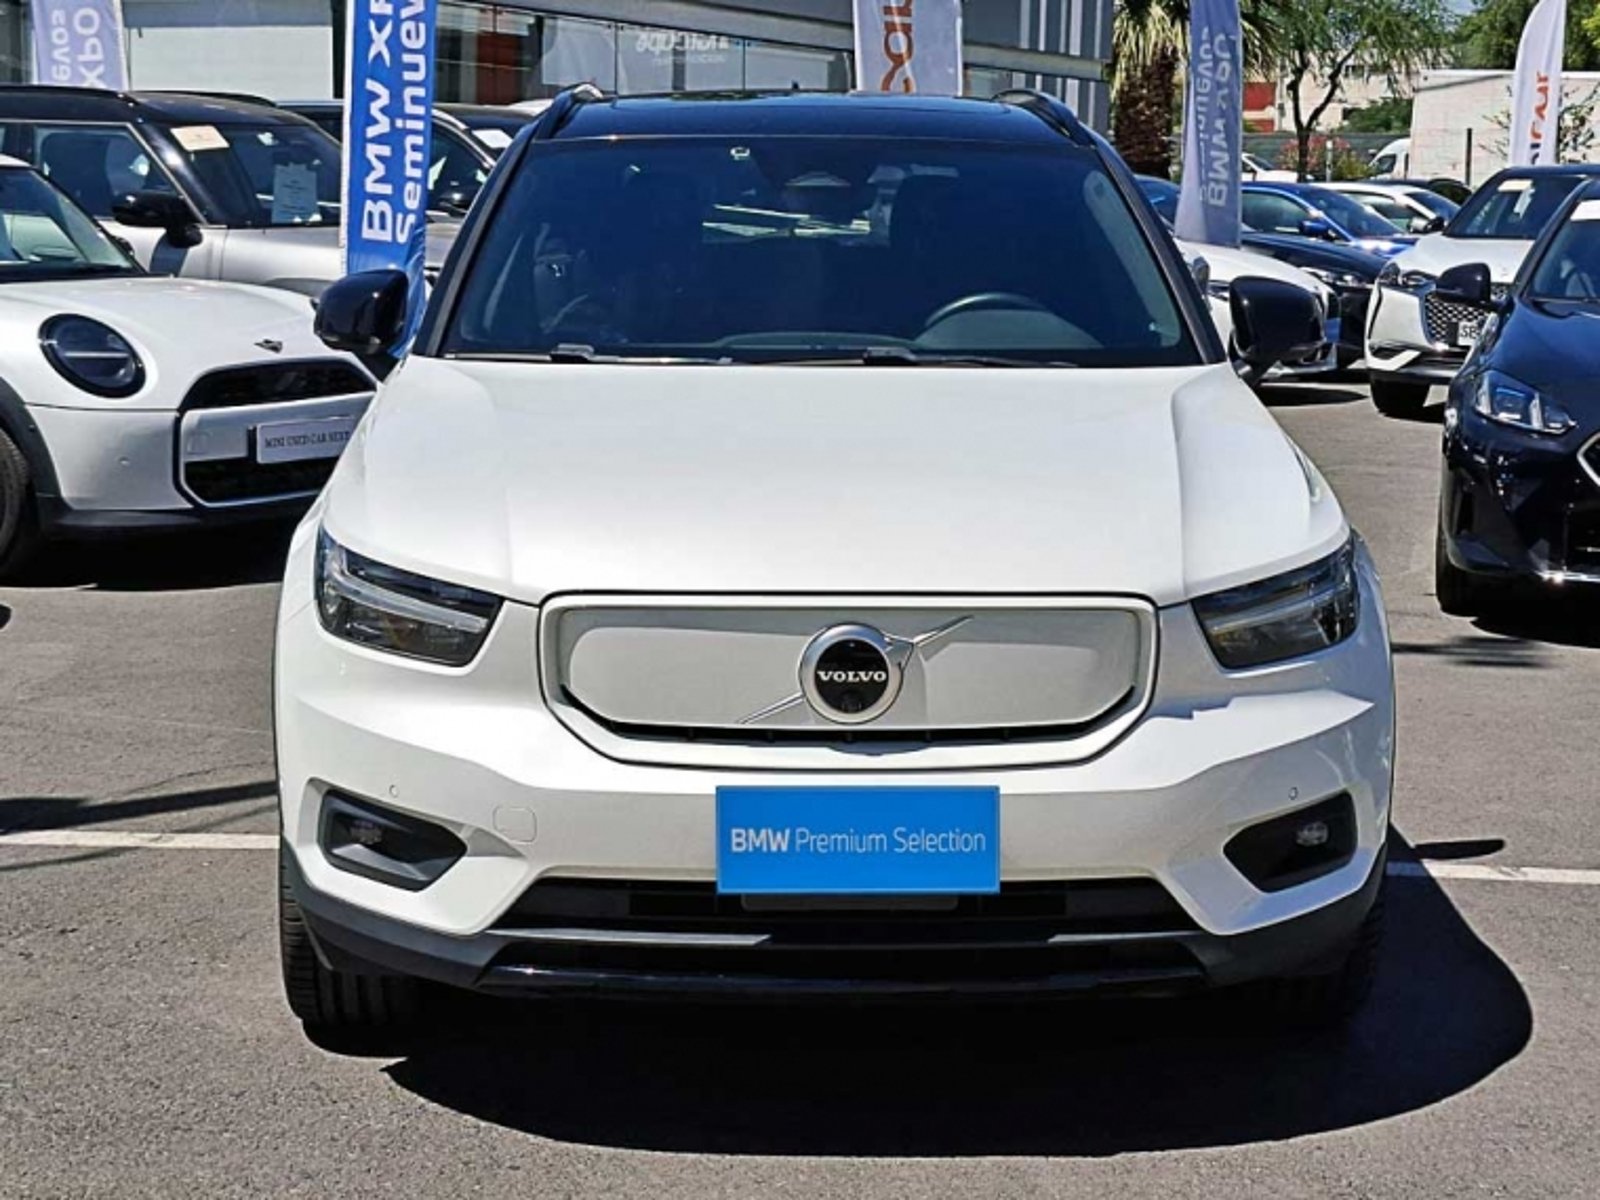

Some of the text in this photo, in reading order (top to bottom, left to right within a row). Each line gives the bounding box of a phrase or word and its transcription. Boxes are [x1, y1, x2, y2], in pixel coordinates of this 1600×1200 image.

[361, 77, 393, 243] BMW
[817, 670, 887, 683] VOLVO
[731, 827, 986, 852] BMW Premium Selection
